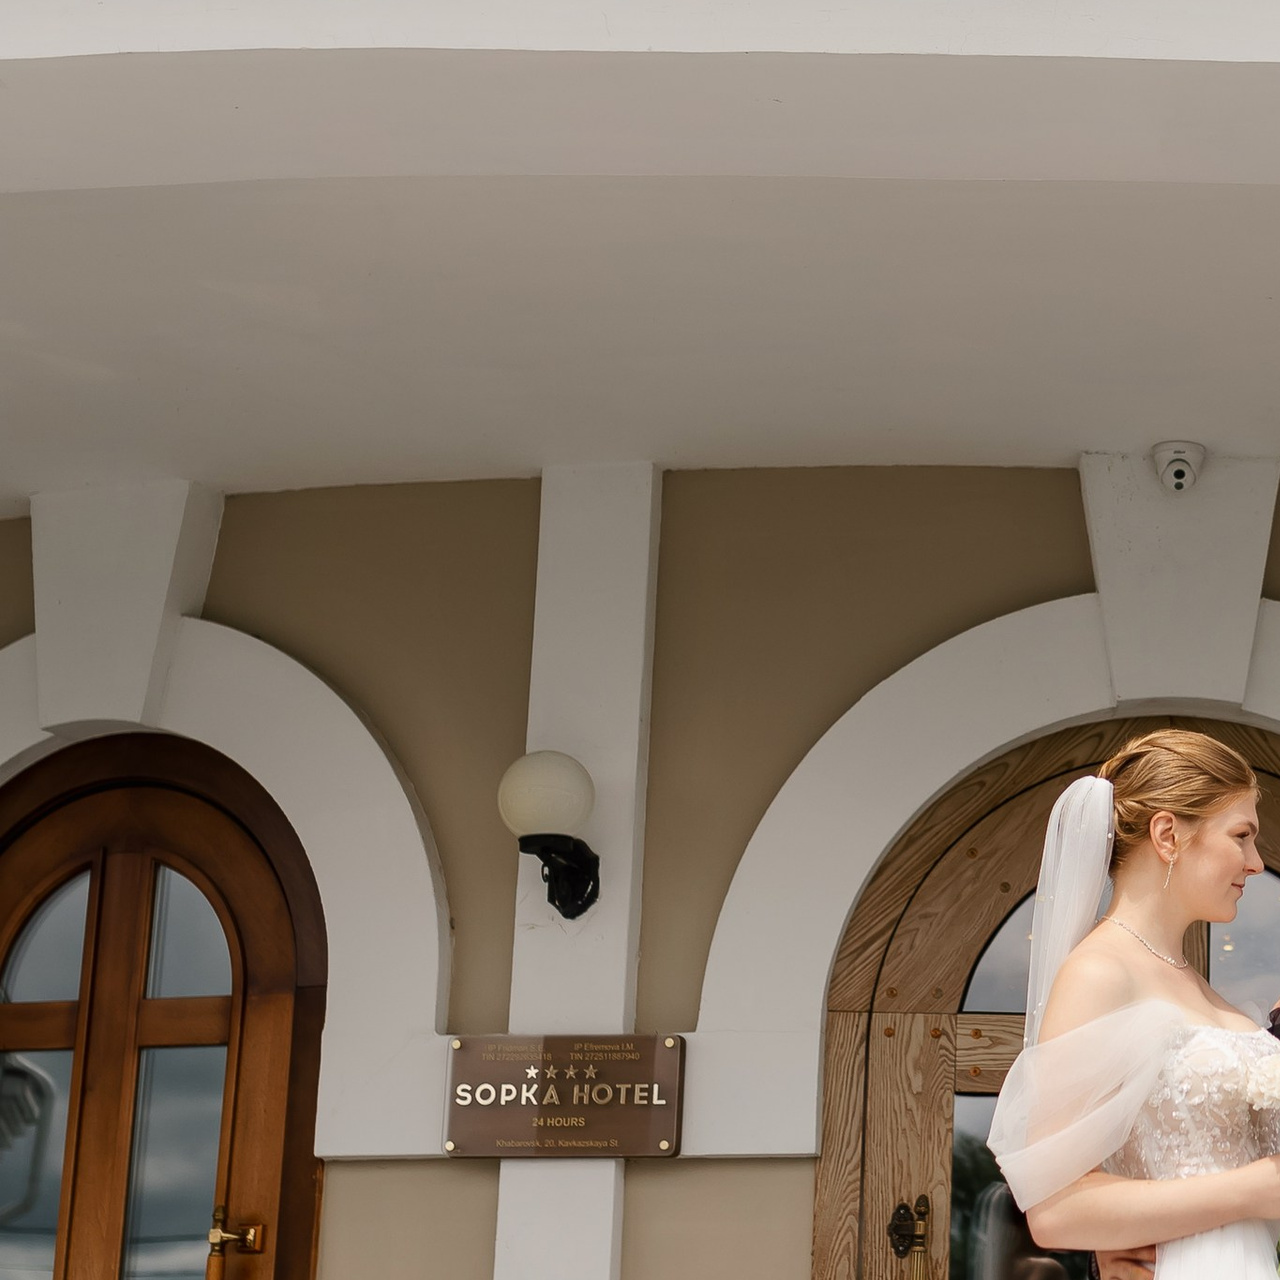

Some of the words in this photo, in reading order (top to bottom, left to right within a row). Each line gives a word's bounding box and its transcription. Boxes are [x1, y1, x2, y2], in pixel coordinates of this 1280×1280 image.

[569, 1052, 583, 1060] TIN
[455, 1083, 560, 1106] SOPKA
[573, 1083, 666, 1106] HOTEL
[532, 1117, 544, 1127] 24
[546, 1117, 585, 1127] HOURS
